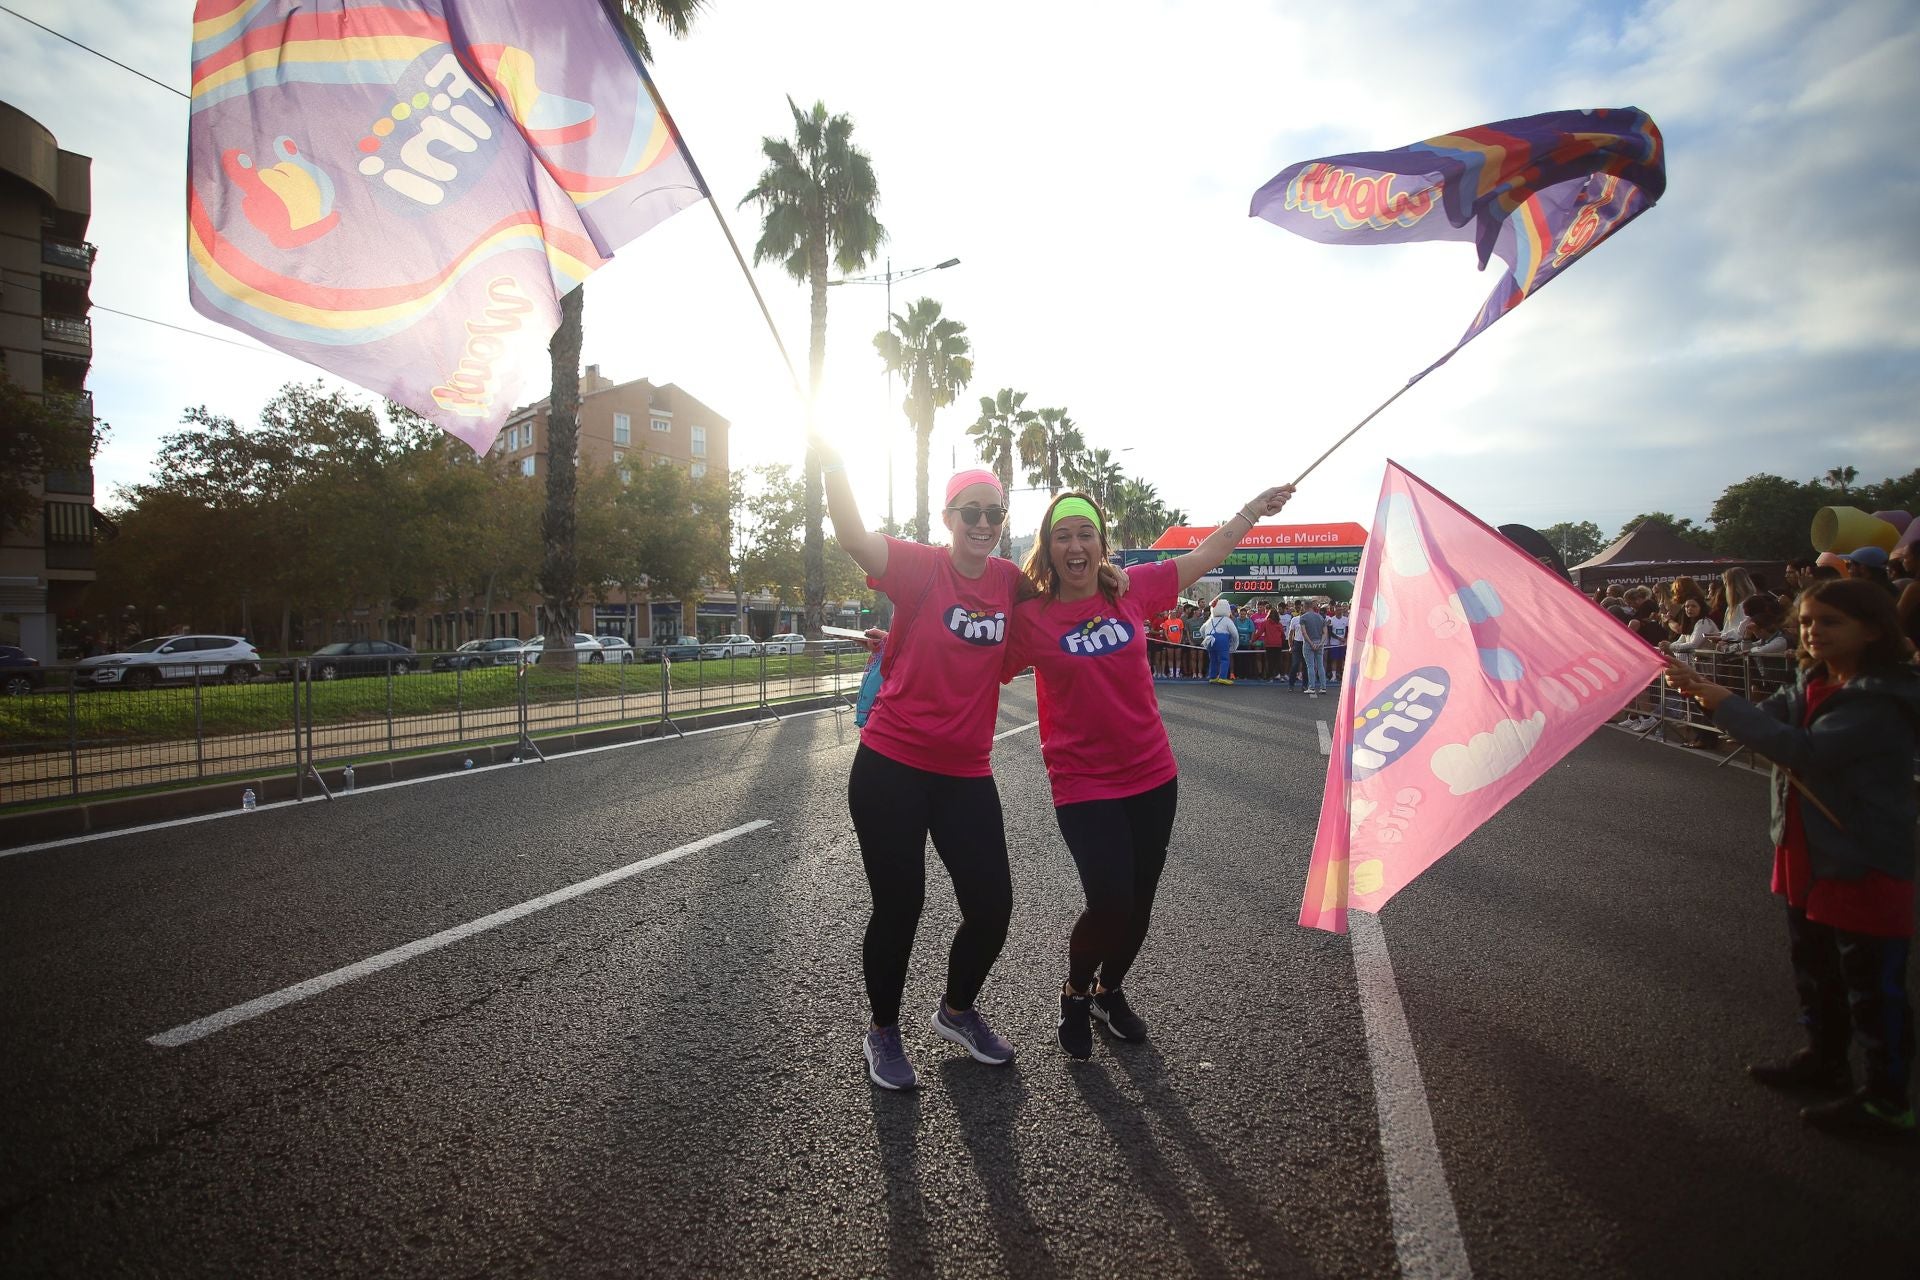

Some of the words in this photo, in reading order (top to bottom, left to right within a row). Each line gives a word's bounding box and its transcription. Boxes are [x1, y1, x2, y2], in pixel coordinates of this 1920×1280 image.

[1275, 533, 1291, 544] de
[1294, 531, 1339, 543] Murcia
[1274, 553, 1295, 566] DE
[1249, 565, 1298, 576] SALIDA
[1324, 566, 1337, 574] LA
[950, 607, 1005, 642] Fini
[1065, 617, 1129, 653] Fini
